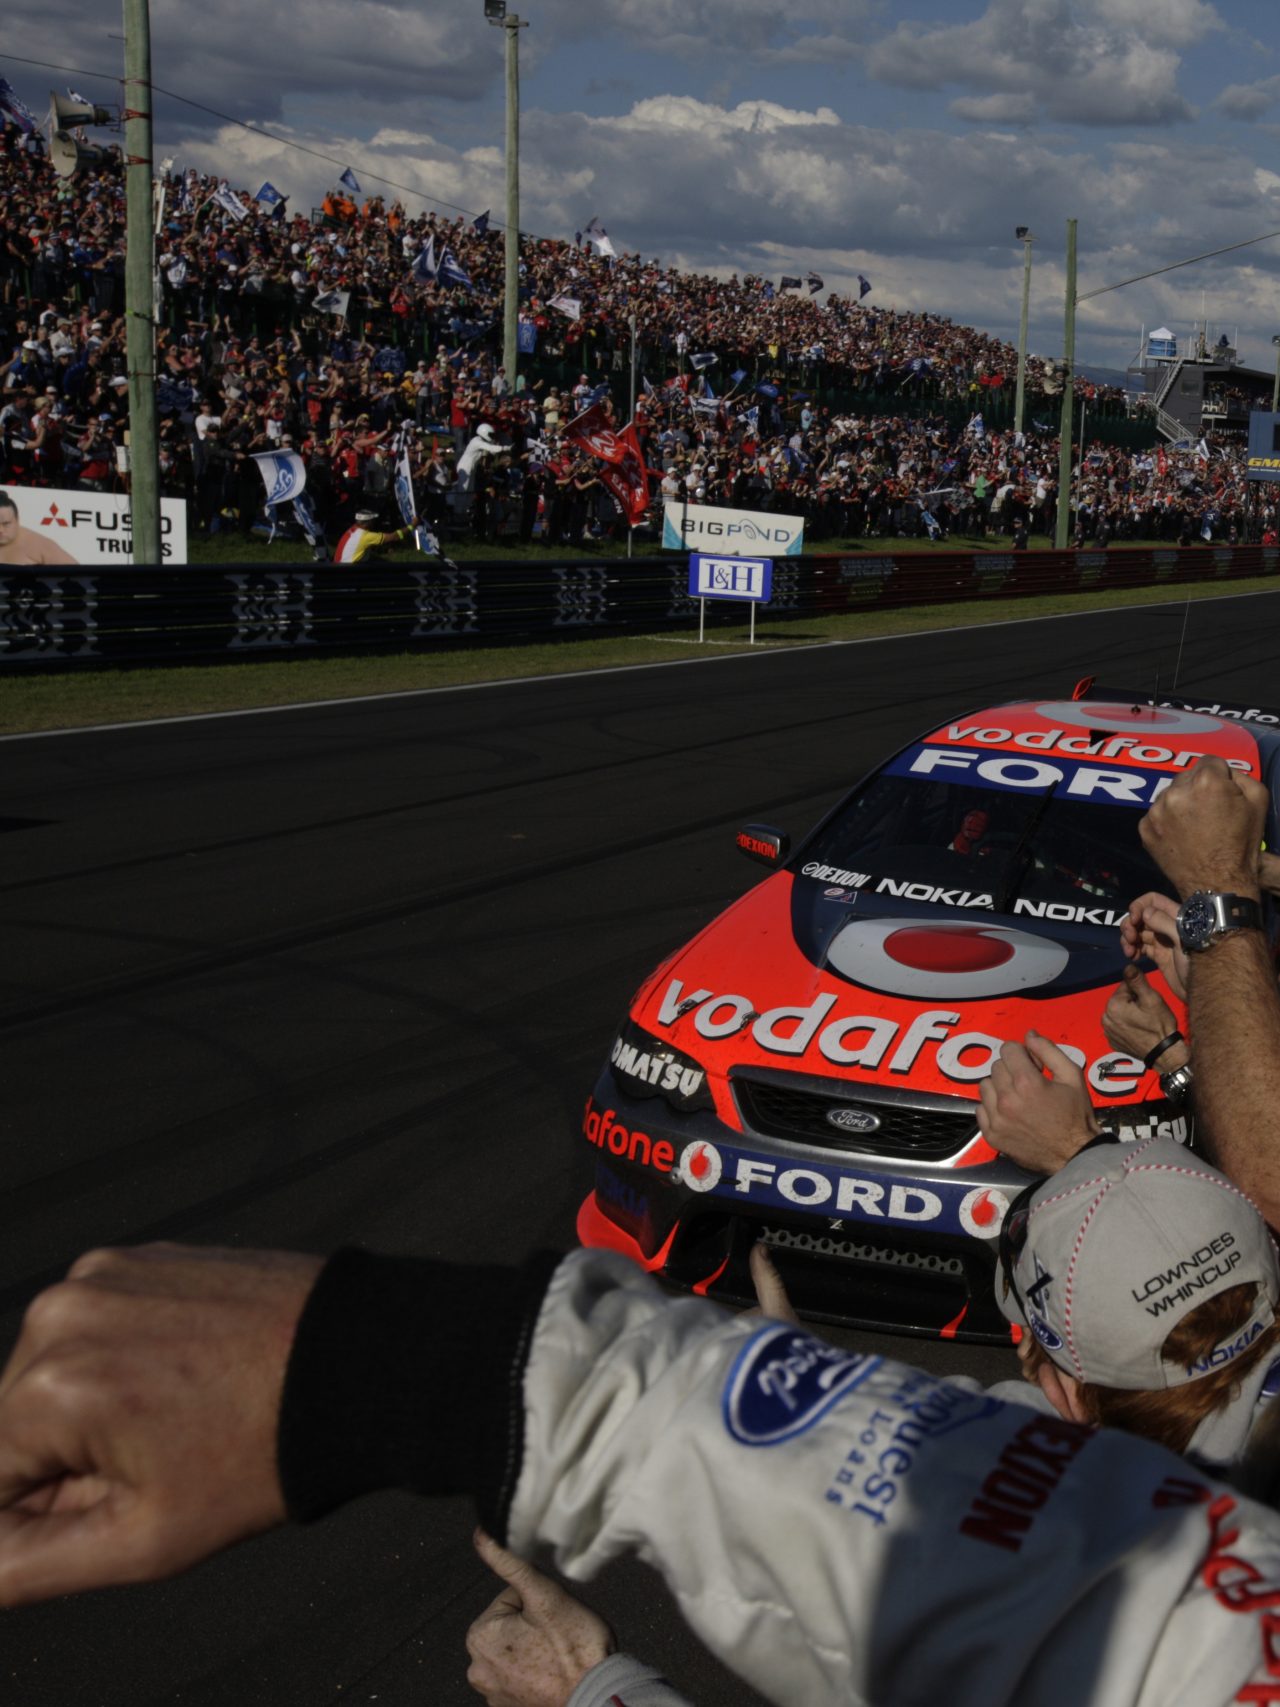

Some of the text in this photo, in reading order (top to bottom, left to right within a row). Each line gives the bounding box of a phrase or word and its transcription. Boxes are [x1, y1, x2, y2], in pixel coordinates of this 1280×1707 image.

[97, 537, 171, 557] TRUS
[681, 519, 790, 542] BIGPOND
[705, 563, 757, 592] I&H
[909, 748, 1173, 803] FOR
[740, 833, 777, 860] DEXION
[812, 864, 872, 888] DEXION
[875, 877, 996, 911] NOKIA
[610, 1037, 705, 1097] OMATSU
[837, 1110, 870, 1128] Ford
[735, 1158, 943, 1222] FORD
[1132, 1232, 1235, 1303] LOWNDES
[1146, 1251, 1242, 1318] WHINCUP
[1187, 1321, 1264, 1376] NOKIA
[826, 1408, 894, 1506] Loans
